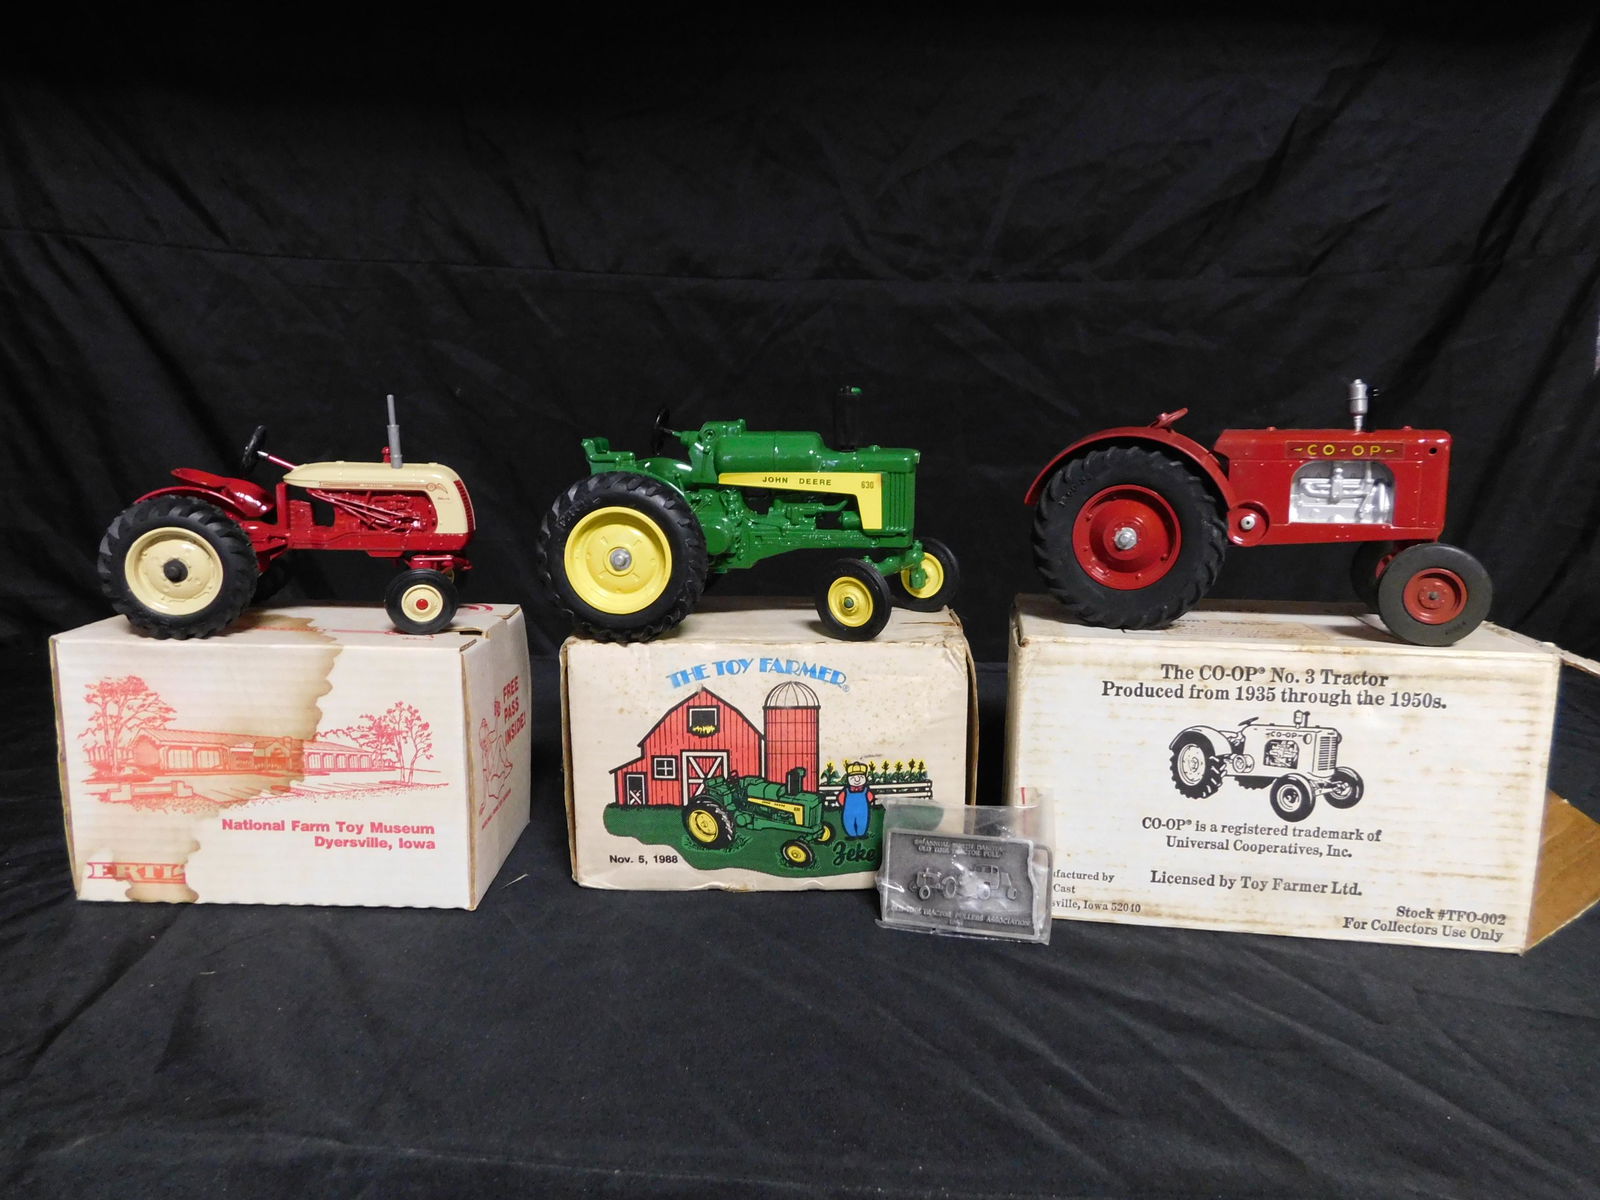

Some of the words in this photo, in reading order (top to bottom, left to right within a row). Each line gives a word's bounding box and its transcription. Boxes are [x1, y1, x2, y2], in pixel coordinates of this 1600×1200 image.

[1307, 444, 1381, 456] CO-OP
[762, 476, 789, 484] JOHN
[799, 478, 832, 486] DEERE
[861, 481, 875, 489] 630
[666, 663, 711, 689] THE
[712, 658, 755, 676] TOY
[1160, 663, 1195, 680] The
[1270, 667, 1300, 684] No.
[1305, 668, 1316, 684] 3
[1320, 669, 1390, 687] Tractor
[502, 675, 519, 703] FREE
[1101, 680, 1185, 699] Produced
[1189, 684, 1230, 700] from
[1235, 685, 1277, 702] 1935
[1281, 687, 1353, 707] through
[1357, 689, 1386, 706] the
[1390, 691, 1448, 710] 1950s.
[503, 697, 520, 724] PASS
[504, 711, 527, 747] INSIDE!
[222, 818, 286, 832] National
[291, 820, 331, 833] Farm
[335, 821, 365, 835] Toy
[370, 821, 436, 835] Museum
[1195, 820, 1207, 832] is
[1209, 823, 1218, 833] a
[1221, 822, 1289, 837] registered
[1292, 826, 1365, 841] trademark
[1367, 829, 1383, 842] of
[314, 835, 393, 851] Dyersville,
[398, 837, 436, 850] Iowa
[832, 841, 876, 867] Zeke
[1166, 835, 1230, 851] Universal
[1233, 839, 1324, 858] Cooperatives,
[1326, 844, 1353, 858] Inc.
[609, 854, 634, 864] Nov.
[638, 855, 648, 865] 5,
[653, 854, 679, 864] 1988
[1053, 869, 1100, 881] factured
[1102, 873, 1115, 883] by
[1150, 869, 1216, 887] Licensed
[1218, 874, 1237, 890] by
[1240, 876, 1269, 892] Toy
[1272, 878, 1329, 894] Farmer
[1330, 881, 1363, 896] Ltd.
[1053, 884, 1076, 894] Cast
[1052, 898, 1081, 911] sville,
[1083, 899, 1109, 911] Iowa
[1396, 905, 1436, 920] Stock
[1437, 909, 1507, 926] #TFO-002
[1341, 916, 1369, 930] For
[1370, 918, 1439, 936] Collectors
[1442, 924, 1467, 938] Use
[1470, 927, 1505, 943] Only
